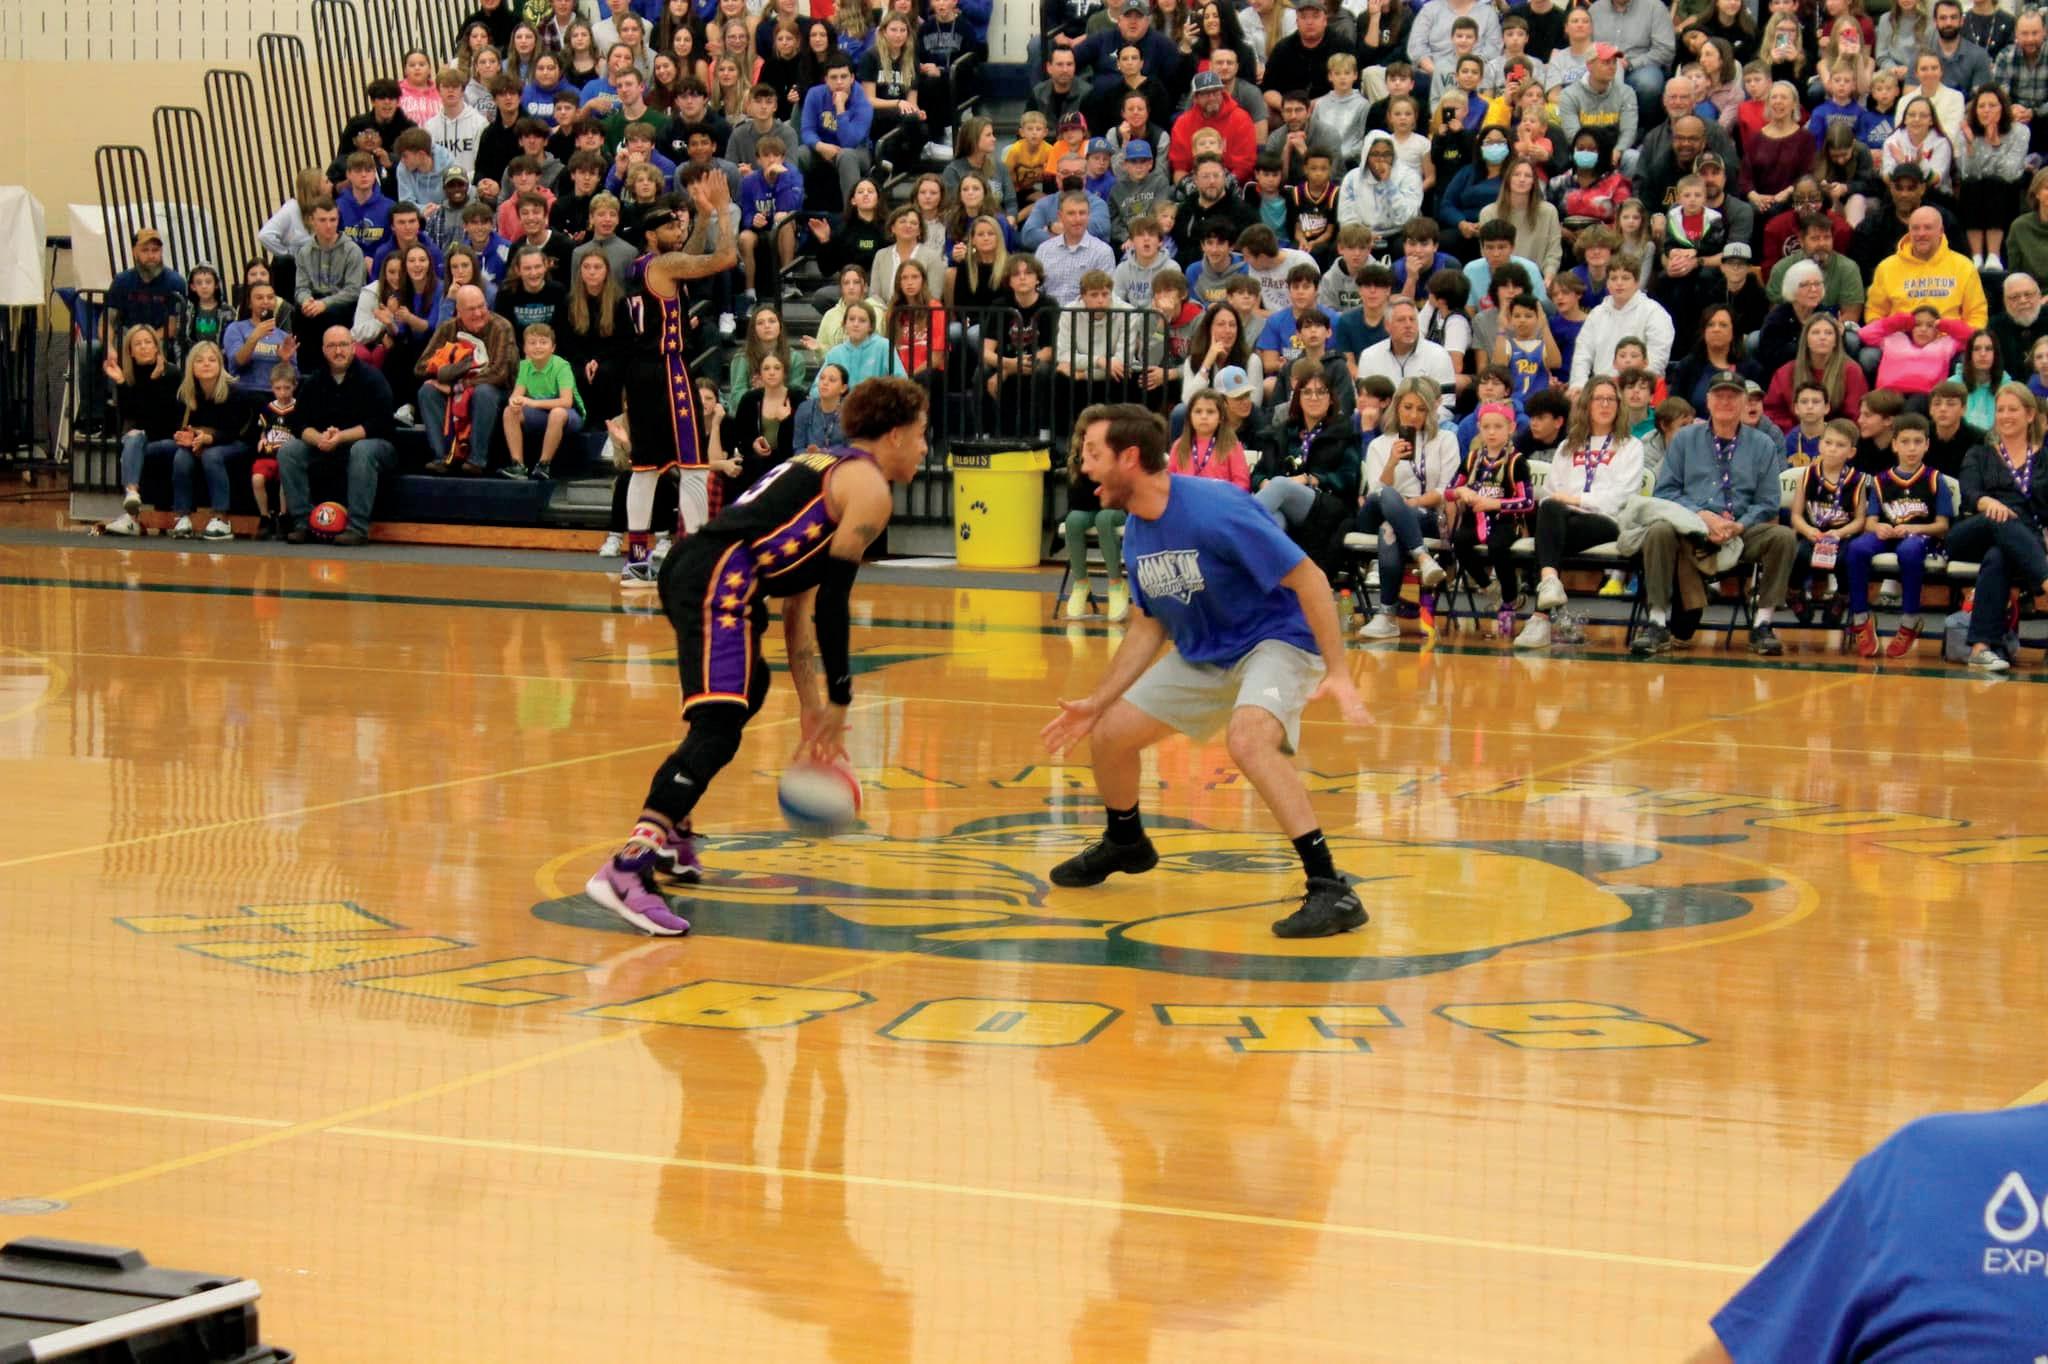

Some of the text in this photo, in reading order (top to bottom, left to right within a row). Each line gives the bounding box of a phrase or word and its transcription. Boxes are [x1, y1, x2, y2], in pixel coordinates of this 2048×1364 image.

[1904, 277, 1955, 290] HAMPTON
[111, 900, 1709, 1054] TALBOTS
[1983, 1246, 2048, 1278] EXP
